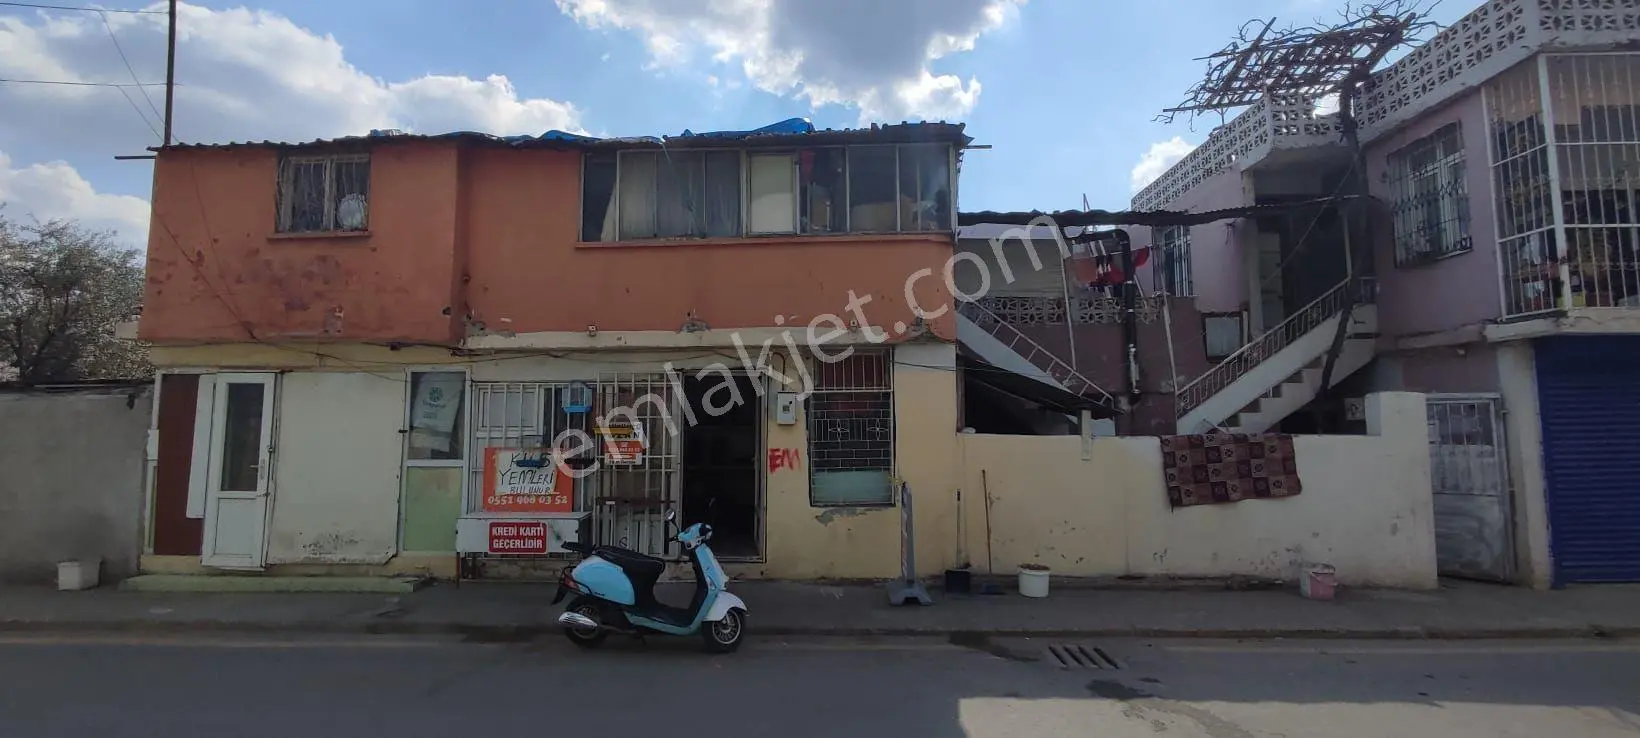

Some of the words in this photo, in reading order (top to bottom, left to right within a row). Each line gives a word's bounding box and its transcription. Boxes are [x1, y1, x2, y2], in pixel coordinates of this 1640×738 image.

[554, 495, 569, 504] 52
[491, 525, 517, 536] KREDİ
[493, 538, 543, 549] GEÇERLİDİR
